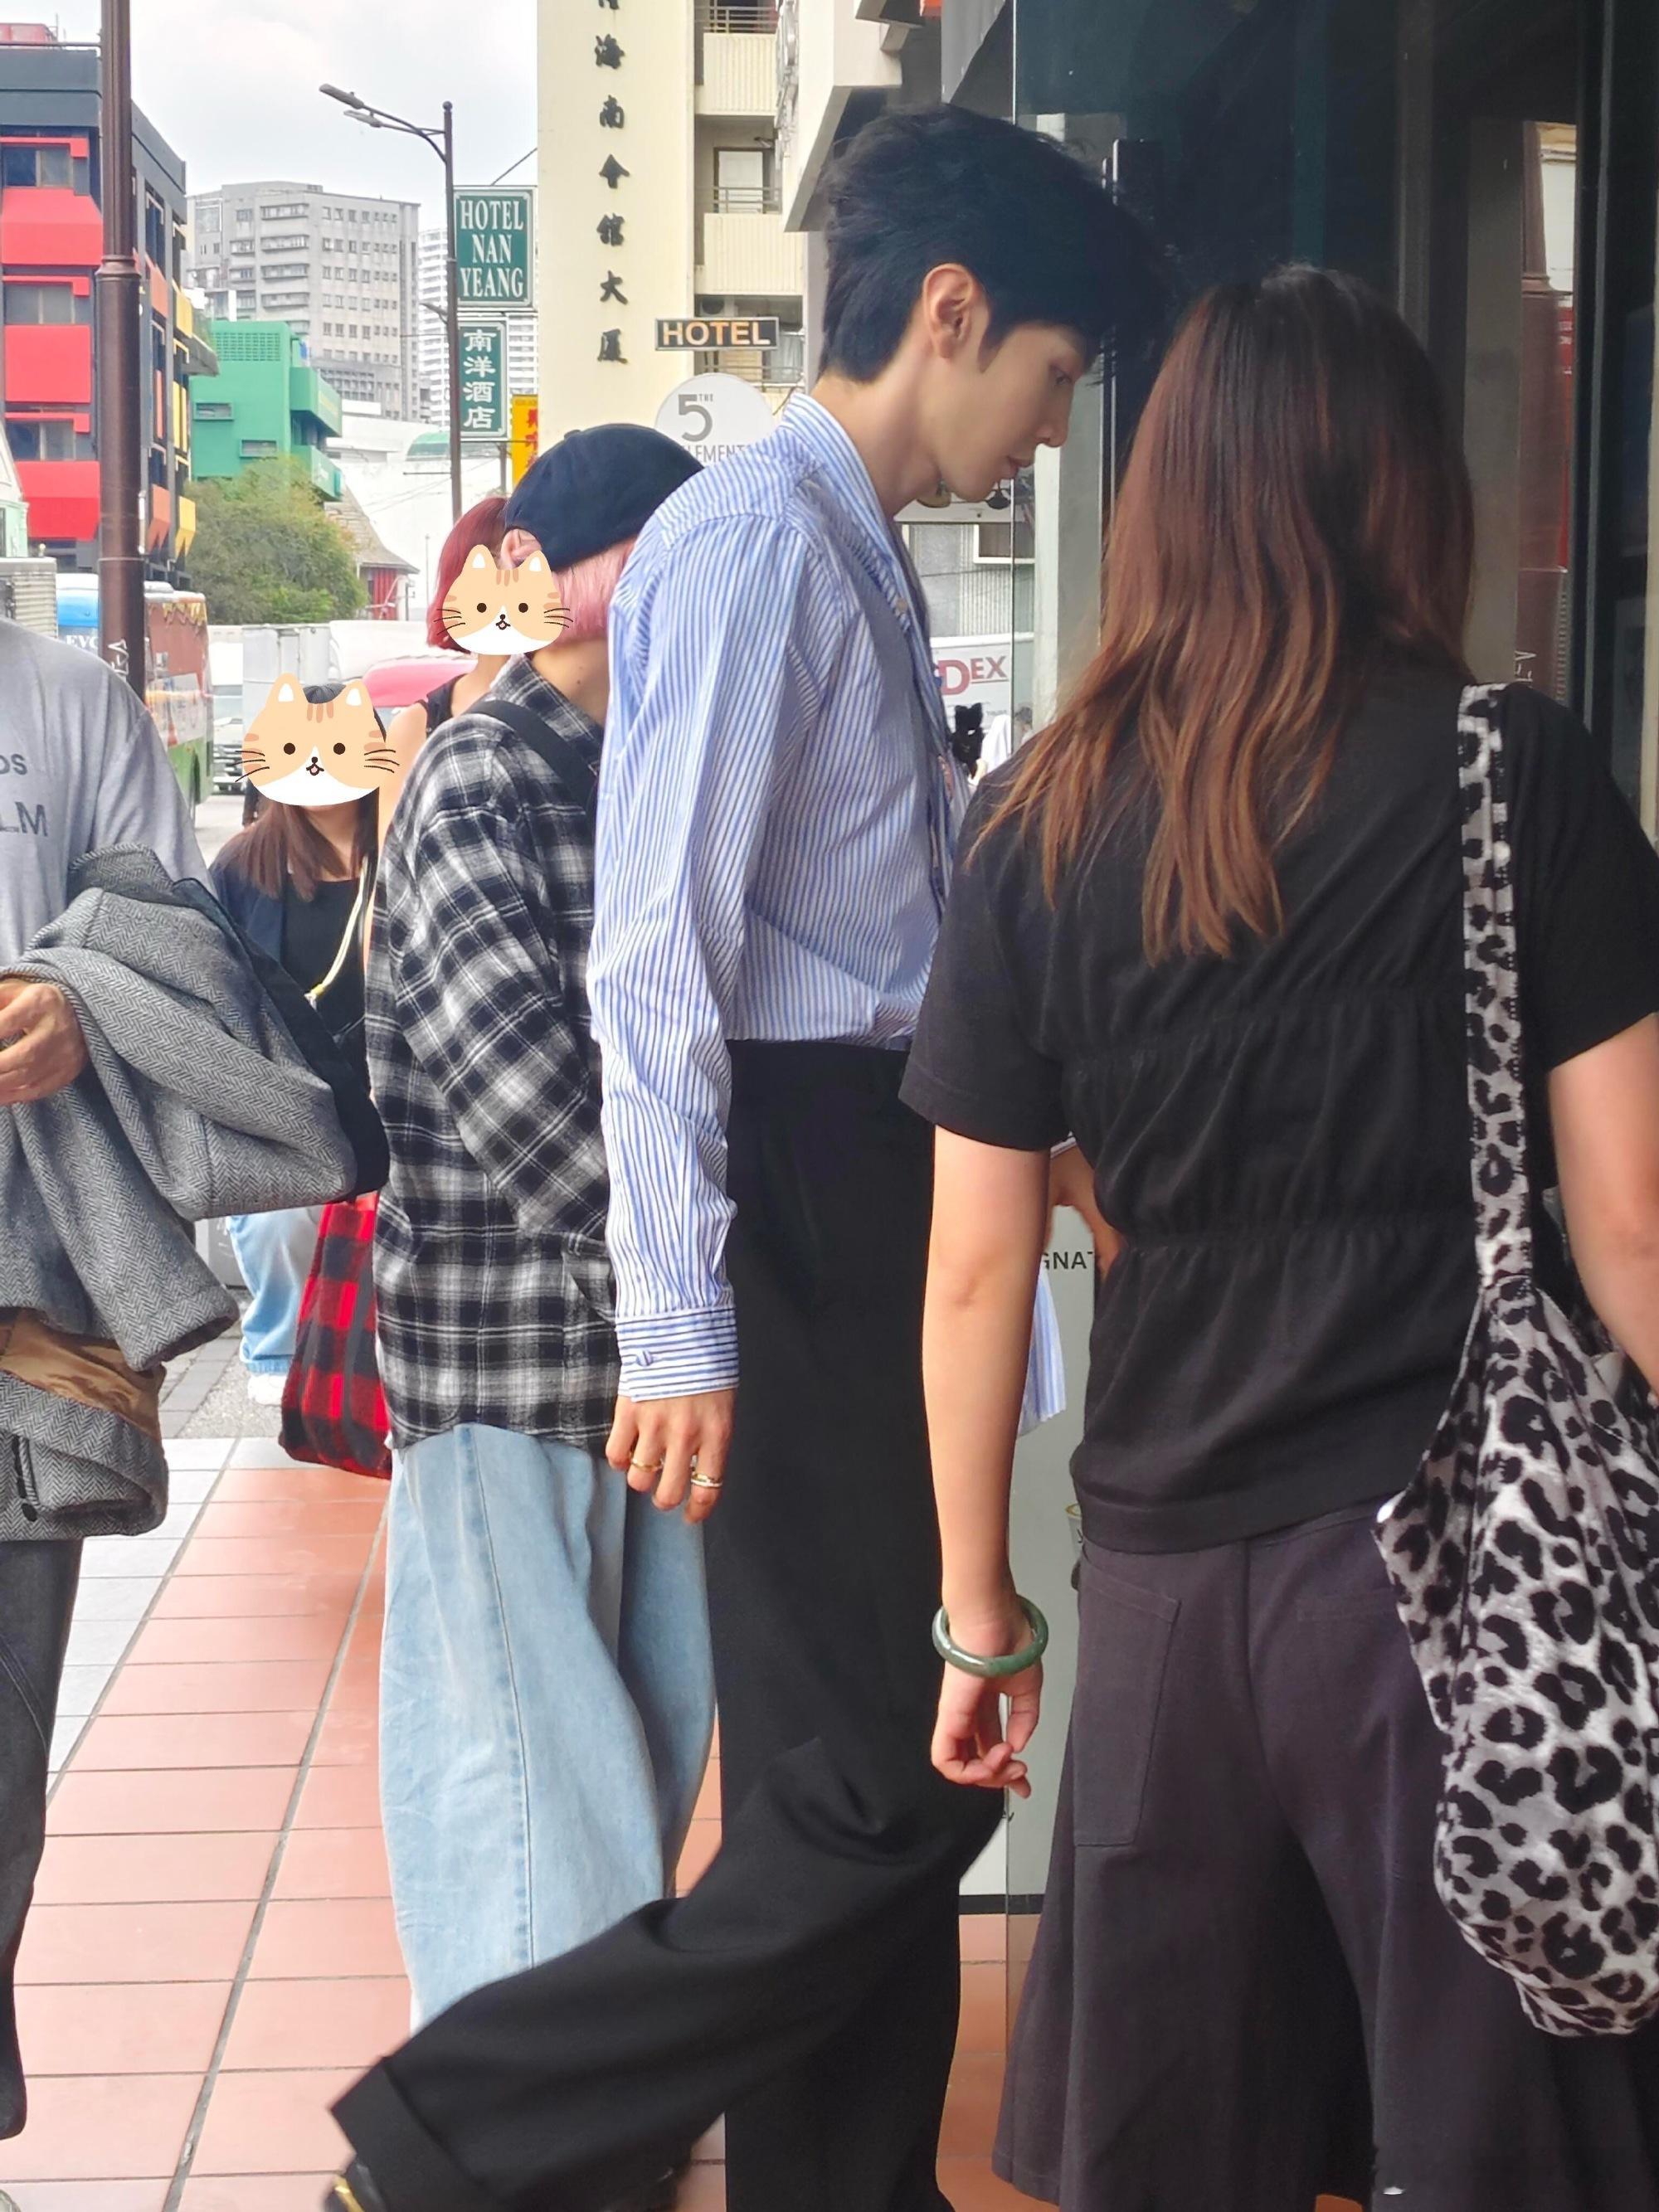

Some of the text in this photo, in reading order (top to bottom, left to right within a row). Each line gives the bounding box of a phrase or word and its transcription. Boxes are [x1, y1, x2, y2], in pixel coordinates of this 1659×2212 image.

[460, 199, 524, 230] HOTEL
[471, 233, 512, 264] NAN
[460, 267, 524, 298] YEANG
[663, 321, 771, 346] HOTEL
[463, 328, 497, 429] 南洋酒店
[678, 394, 713, 442] 5
